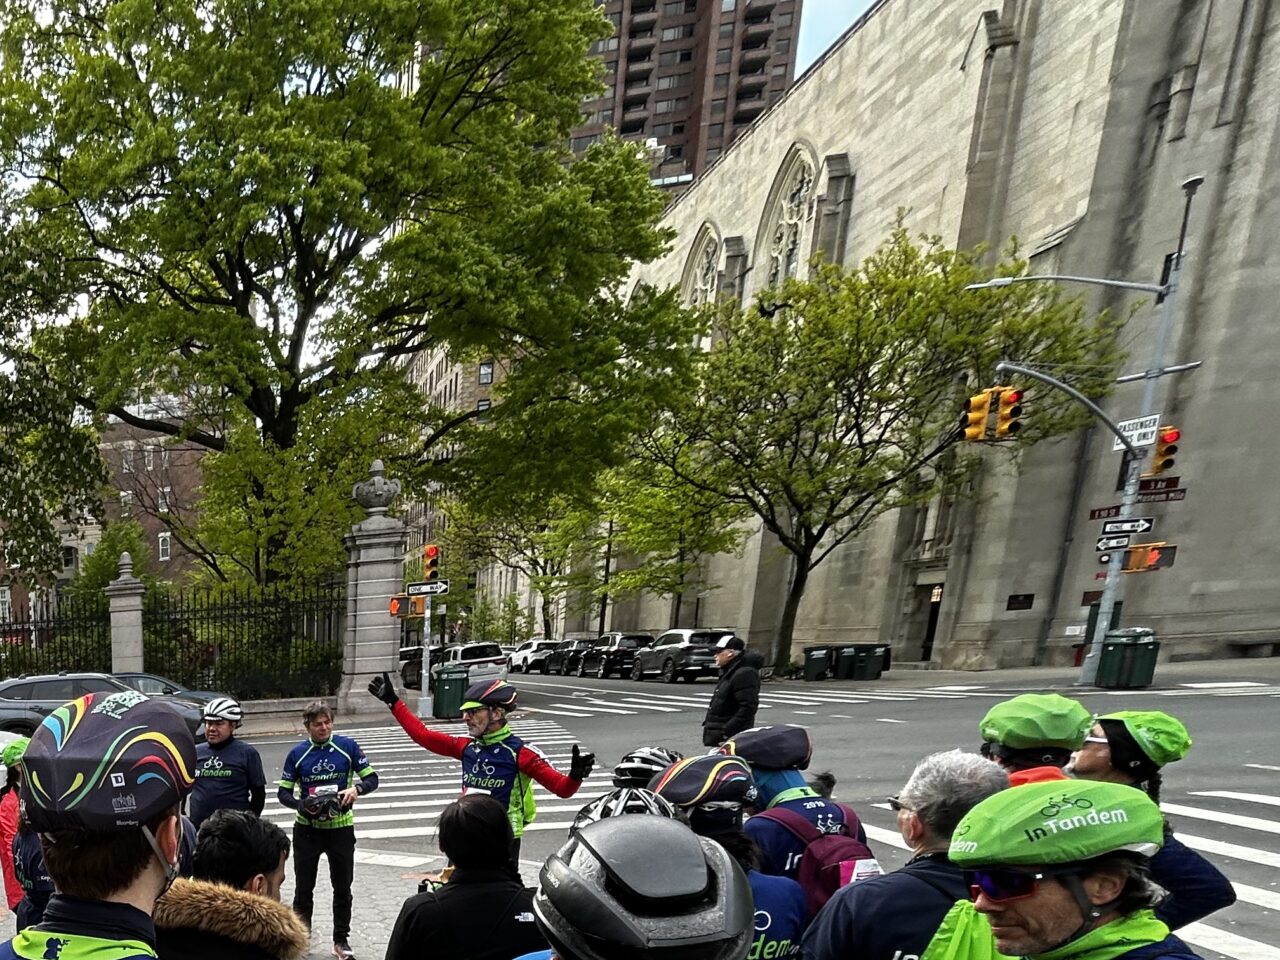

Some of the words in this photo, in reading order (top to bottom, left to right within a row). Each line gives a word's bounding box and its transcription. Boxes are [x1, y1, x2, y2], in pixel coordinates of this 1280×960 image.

[1119, 418, 1157, 432] PASSENGER
[1137, 431, 1155, 443] ONLY
[1024, 807, 1129, 843] InTandem
